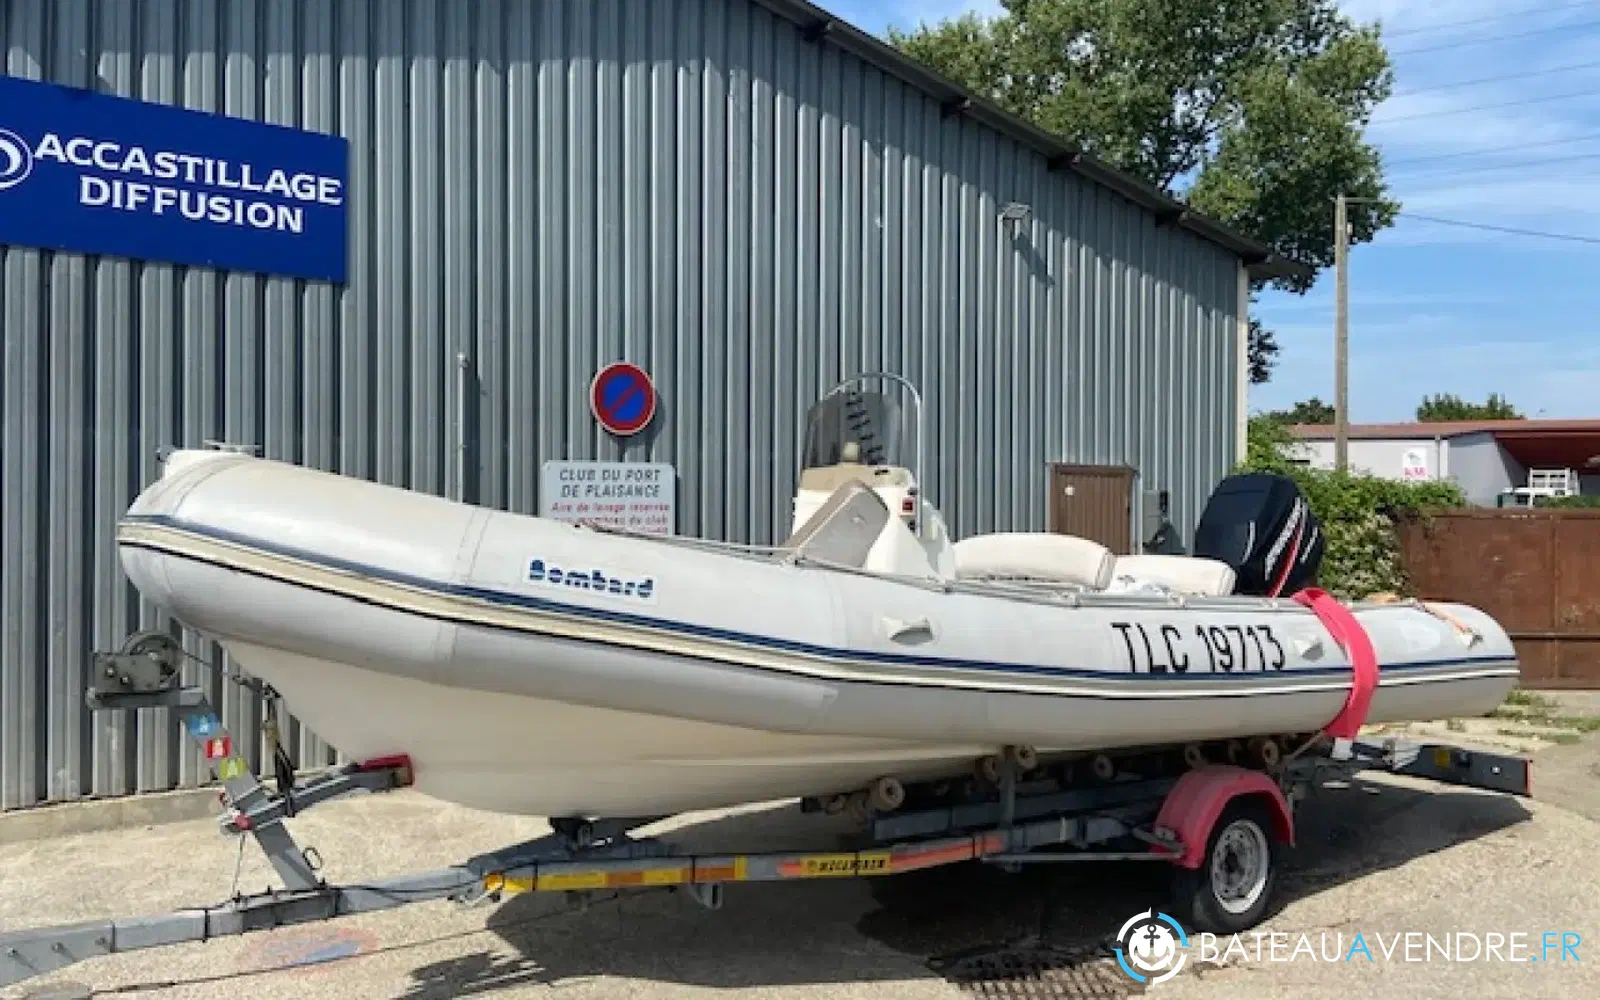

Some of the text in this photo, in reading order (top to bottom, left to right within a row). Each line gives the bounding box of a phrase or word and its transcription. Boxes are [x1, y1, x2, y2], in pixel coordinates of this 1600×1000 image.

[34, 133, 342, 205] ACCASTILLAGE
[79, 175, 304, 233] DIFFUSION
[559, 469, 661, 481] CLUB DU PORT
[561, 484, 660, 497] DE PLAISANCE
[529, 559, 654, 598] Bombard
[1110, 622, 1285, 672] TLC 19713
